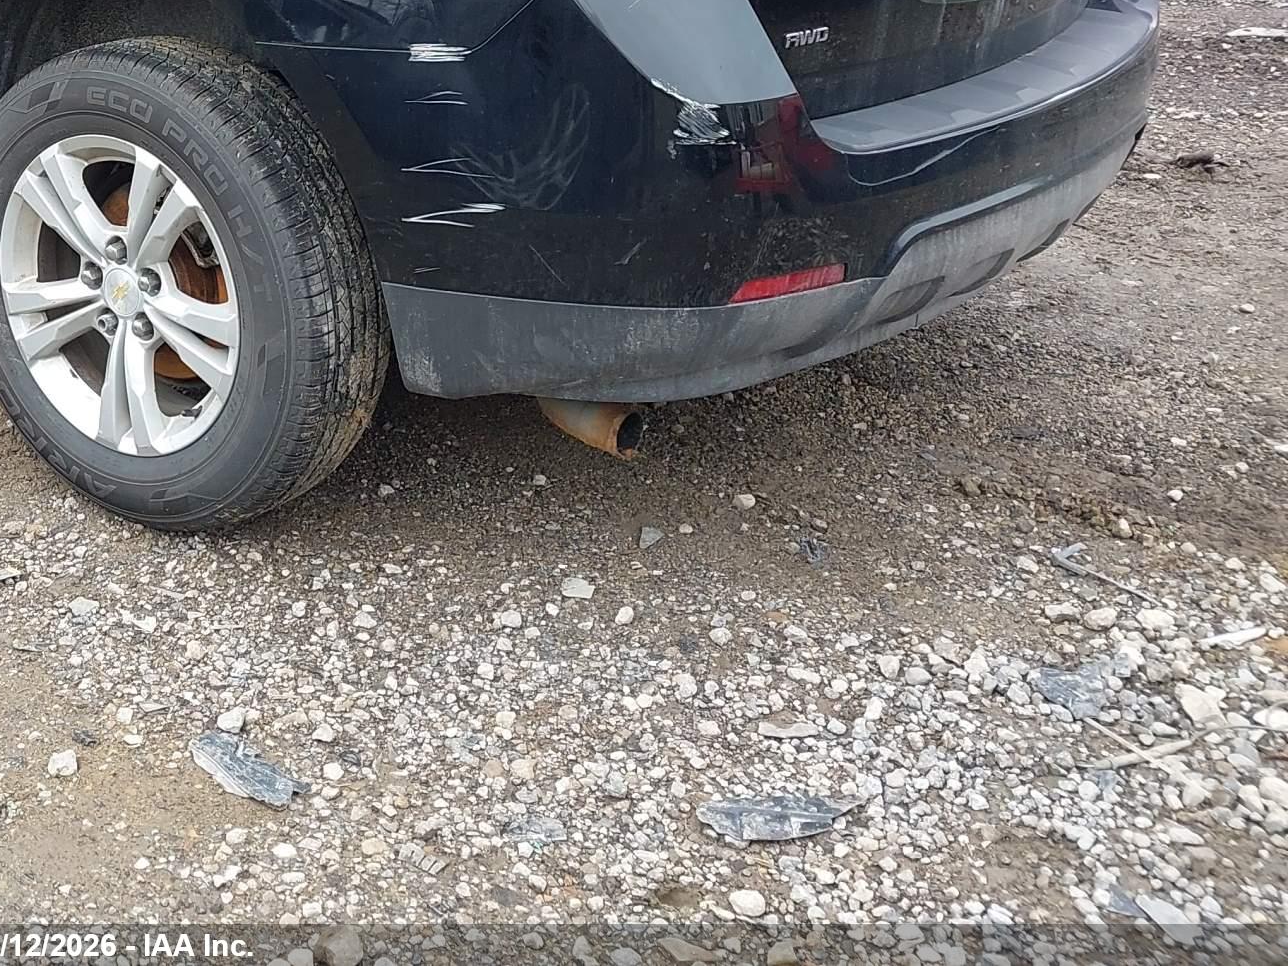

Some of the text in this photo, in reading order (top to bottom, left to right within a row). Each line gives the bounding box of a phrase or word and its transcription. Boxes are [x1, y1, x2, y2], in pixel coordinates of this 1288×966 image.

[785, 26, 829, 49] AWD
[86, 86, 153, 124] ECO
[161, 117, 229, 196] PRO
